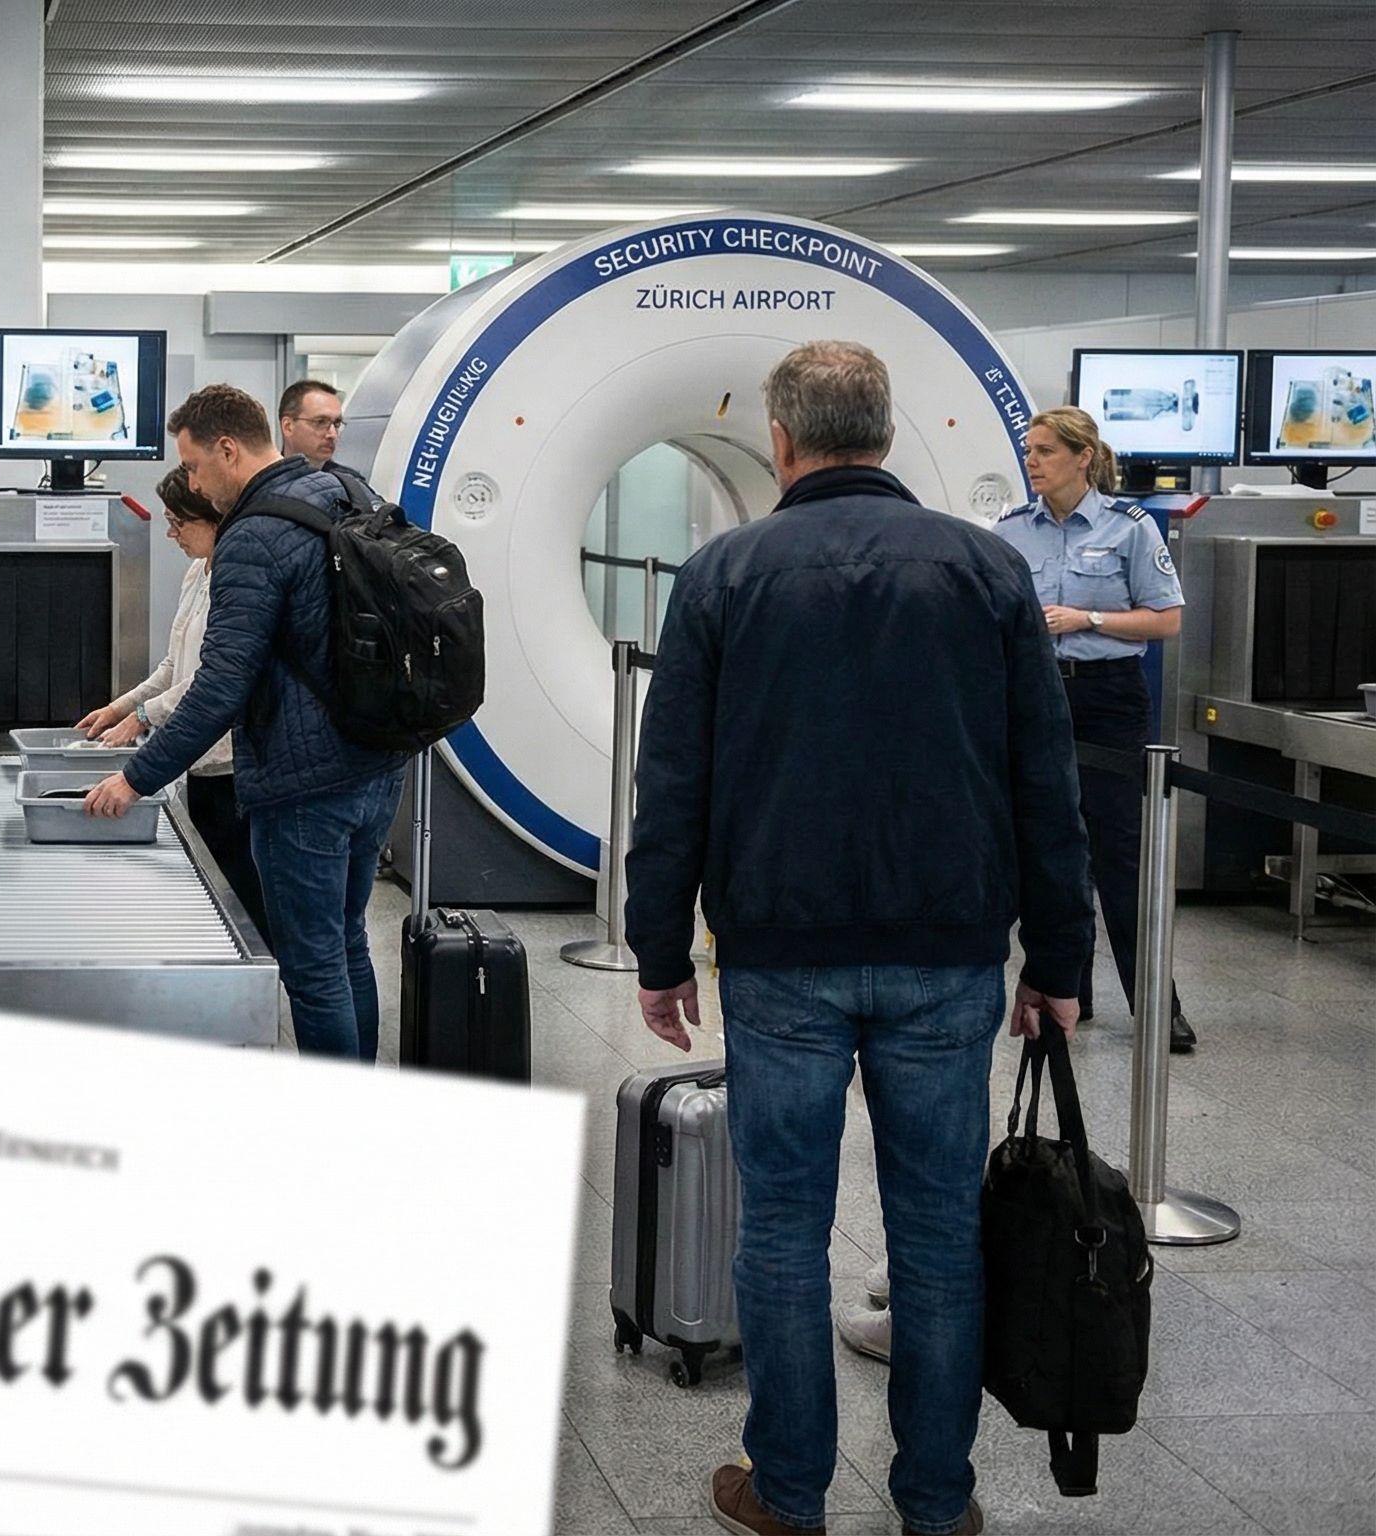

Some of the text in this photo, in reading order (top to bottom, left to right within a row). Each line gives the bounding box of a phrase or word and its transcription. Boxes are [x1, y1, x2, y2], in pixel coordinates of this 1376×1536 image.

[593, 226, 883, 280] SECURITY CHECKPOINT
[635, 284, 836, 311] ZÜRICH AIRPORT
[107, 1253, 486, 1471] Zeitung
